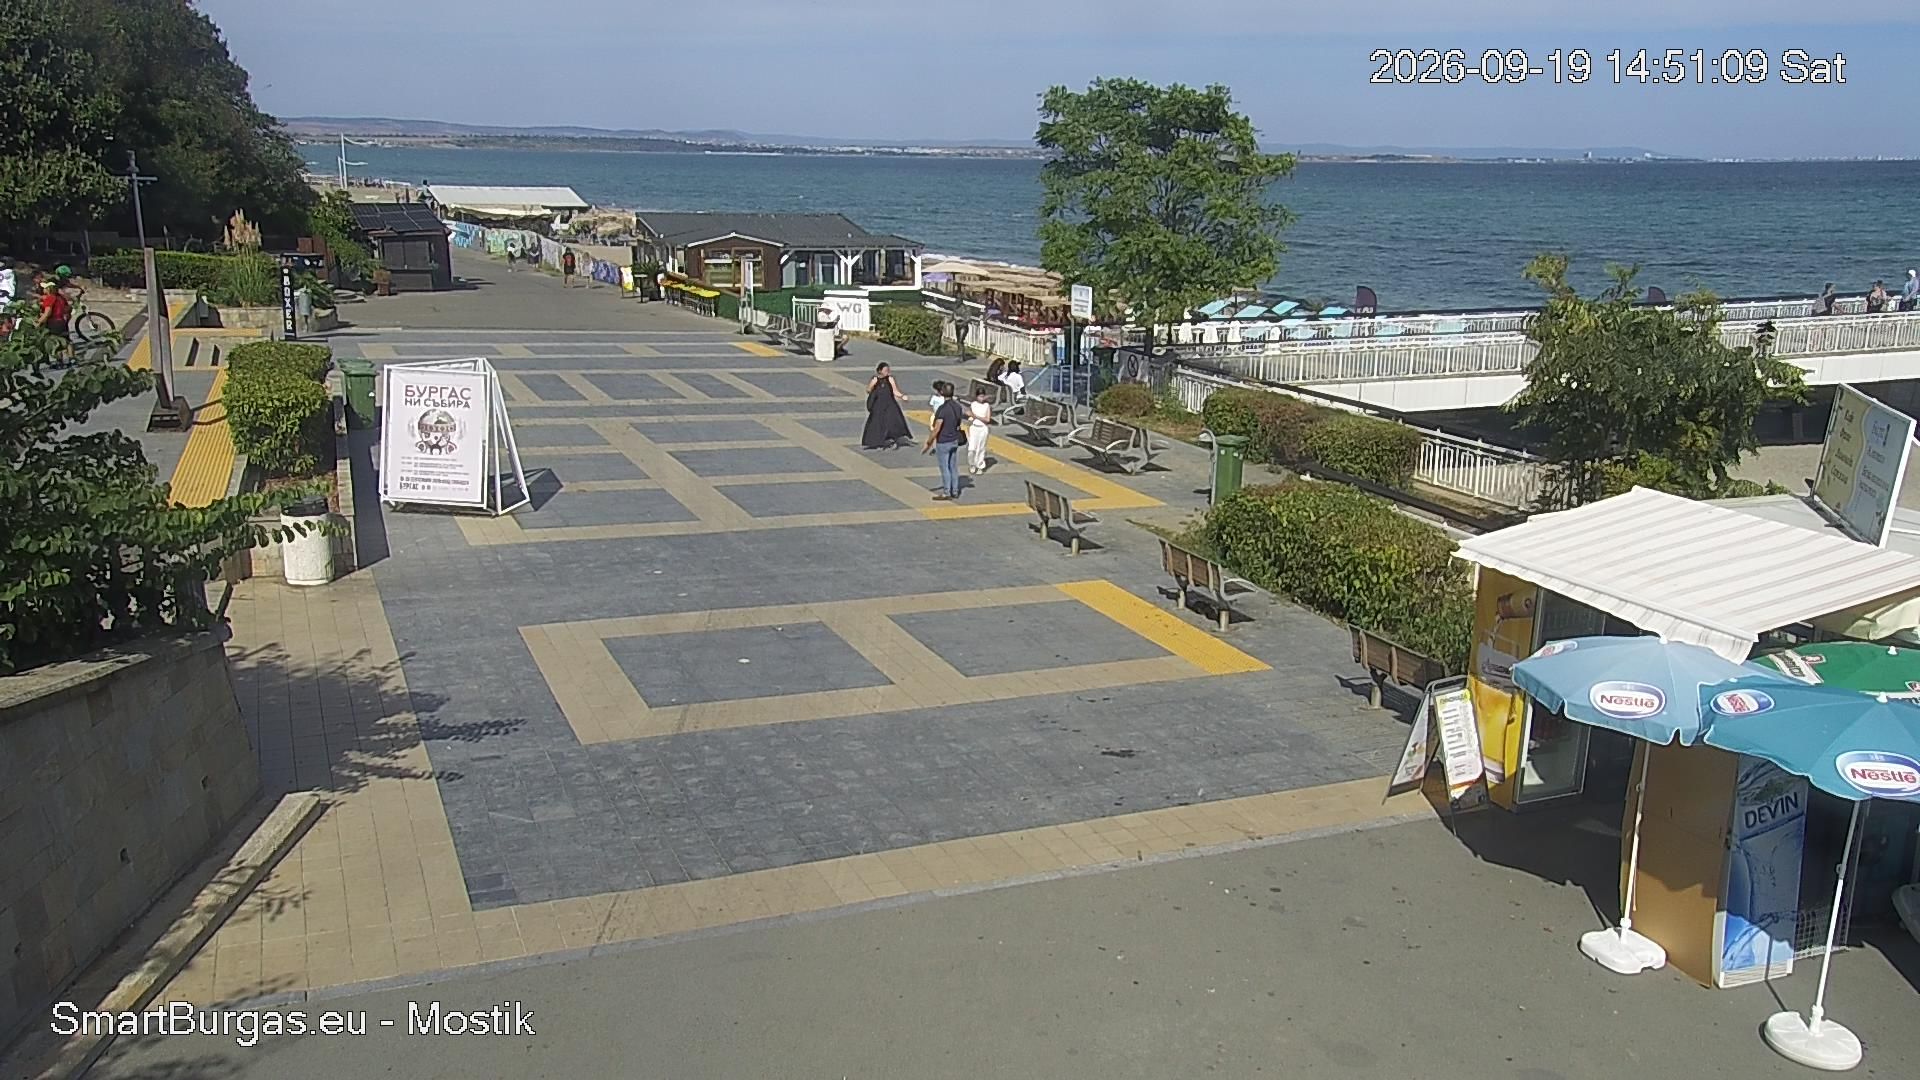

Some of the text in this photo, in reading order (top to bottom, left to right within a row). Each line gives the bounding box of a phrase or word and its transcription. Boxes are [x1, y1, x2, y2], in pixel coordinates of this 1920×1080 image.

[404, 385, 472, 400] БУРГАС
[404, 398, 471, 409] НИ СЪБИРА
[1744, 791, 1799, 829] DEVIN
